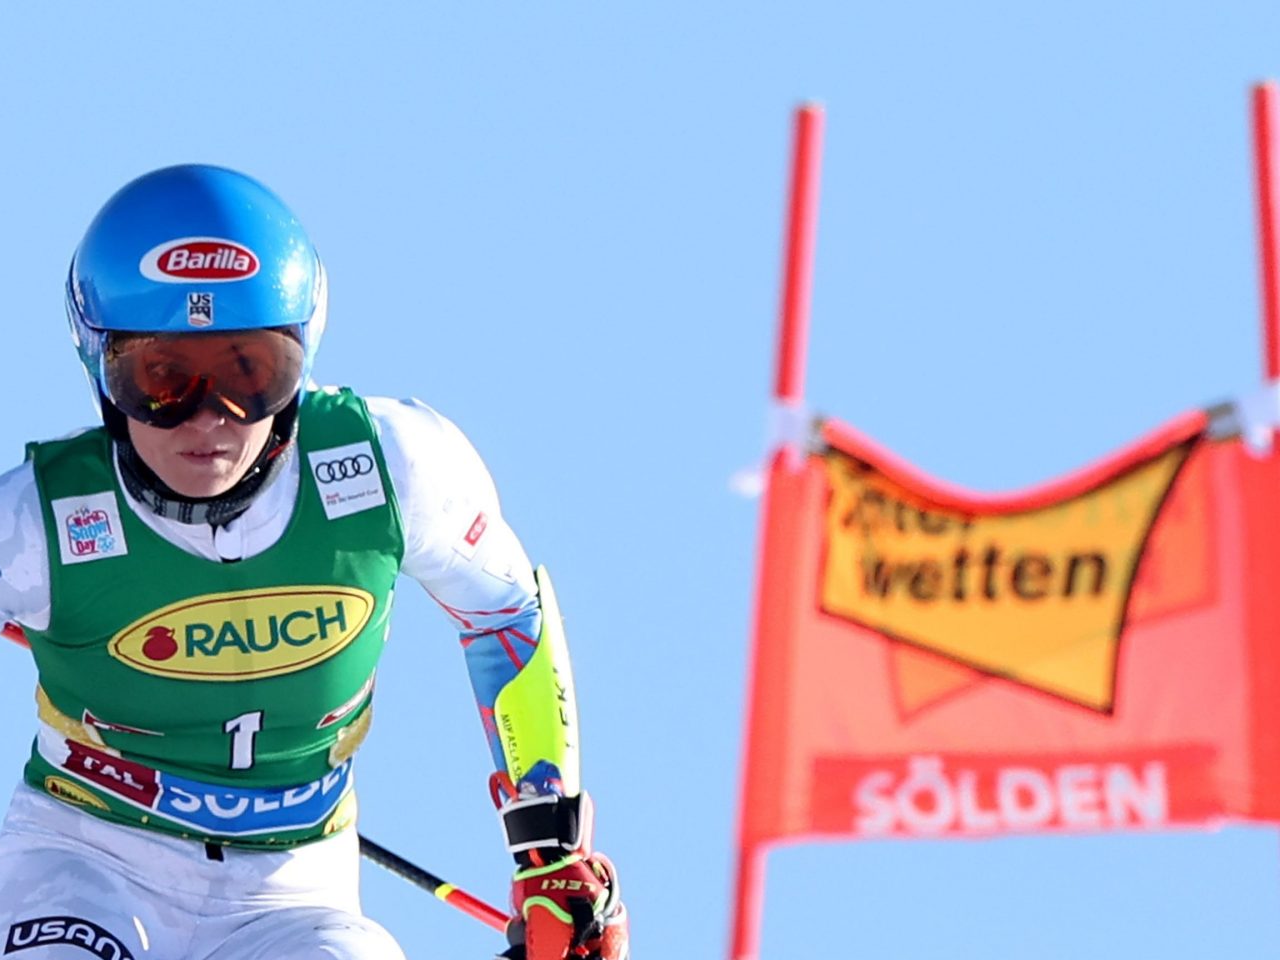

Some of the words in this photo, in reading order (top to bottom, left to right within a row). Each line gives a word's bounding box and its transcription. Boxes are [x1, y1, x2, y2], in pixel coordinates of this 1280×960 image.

[166, 248, 251, 272] Barilla
[189, 293, 211, 306] US
[185, 600, 347, 658] RAUCH
[223, 710, 264, 770] 1
[851, 756, 1169, 833] SÖLDEN
[540, 879, 598, 892] LEKI
